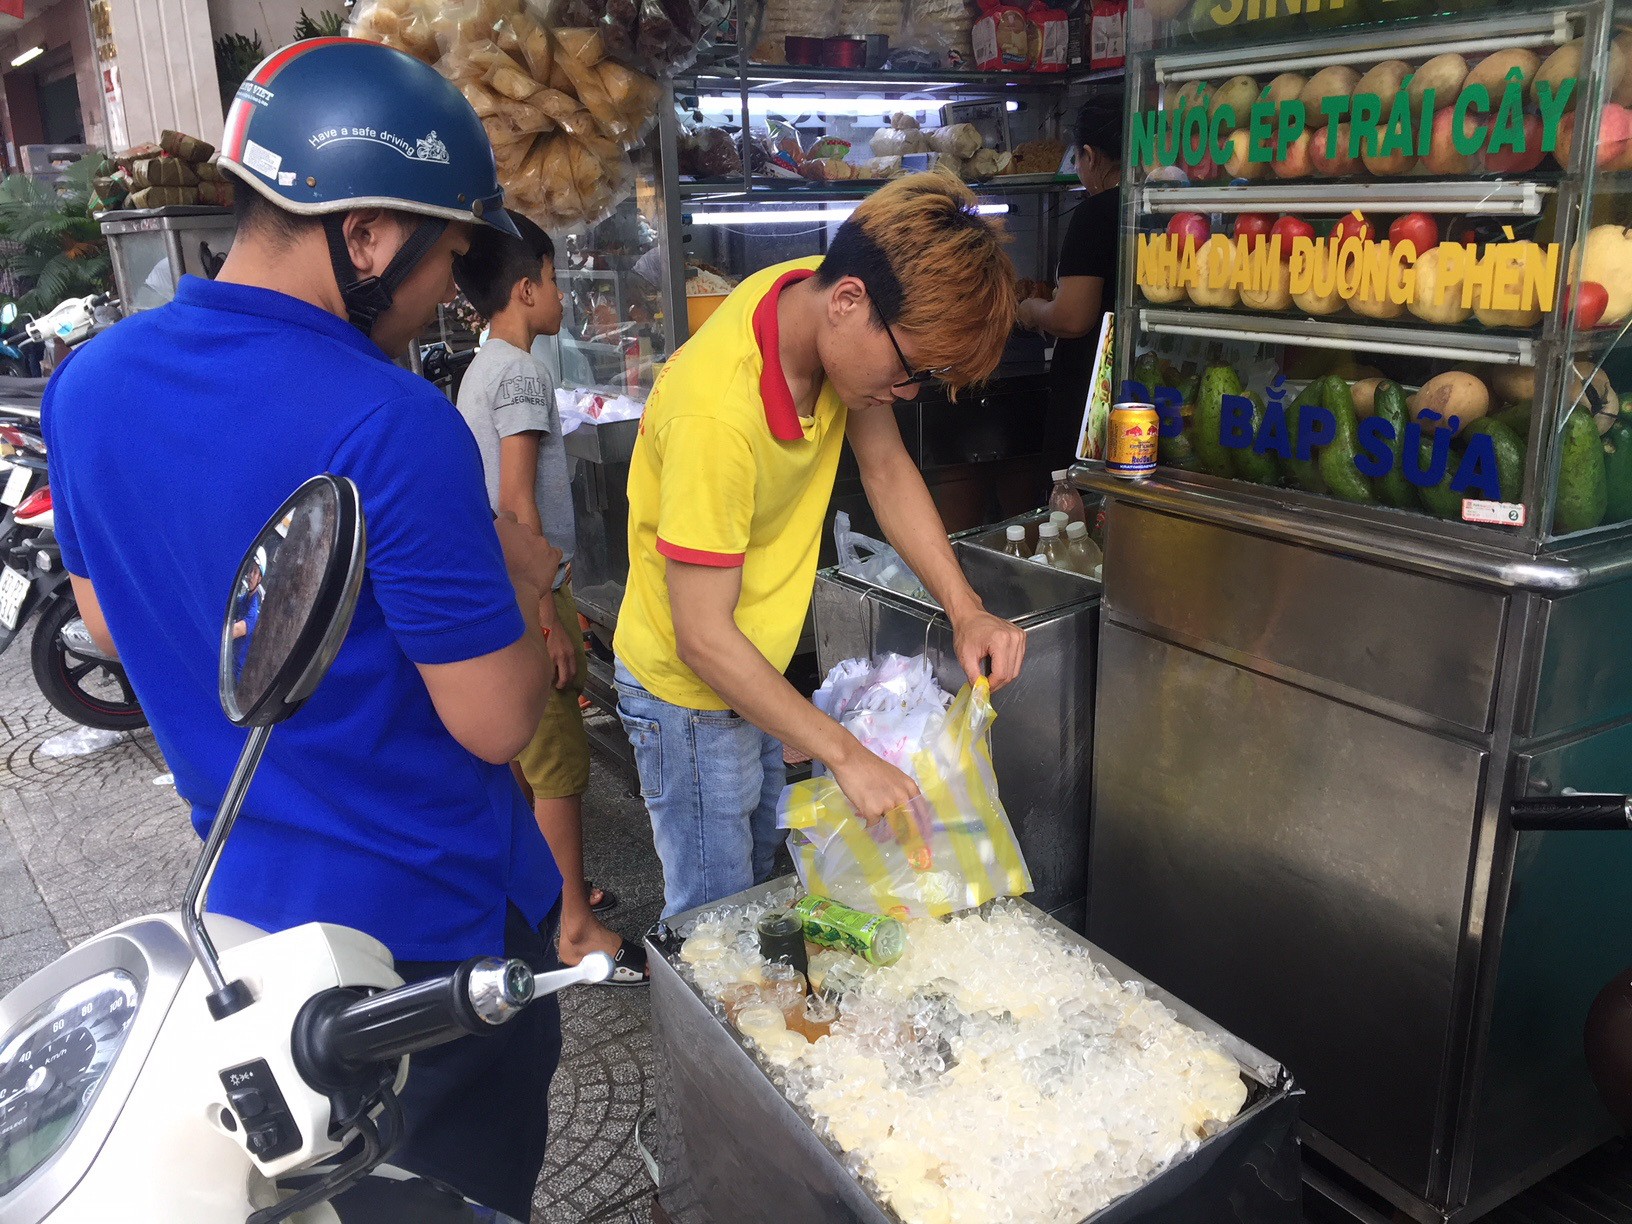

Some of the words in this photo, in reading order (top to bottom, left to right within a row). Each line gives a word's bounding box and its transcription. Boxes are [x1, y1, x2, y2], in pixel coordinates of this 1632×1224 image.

[1131, 82, 1236, 167] NƯỚC
[1249, 85, 1306, 162] ÉP
[1321, 74, 1436, 159] TRÁI
[1452, 66, 1577, 156] CÂY
[308, 128, 337, 147] Have
[341, 127, 348, 135] a
[352, 126, 377, 137] safe
[380, 130, 415, 156] driving
[1137, 233, 1200, 288] NHA
[1289, 208, 1418, 305] ĐƯỜNG
[1436, 225, 1560, 312] PHÈN
[1219, 375, 1337, 461] BẮP
[1353, 408, 1501, 500] SỮA
[81, 1002, 93, 1016] 80
[109, 996, 123, 1013] 100
[53, 1019, 64, 1033] 60
[19, 1050, 31, 1063] 40
[45, 1048, 67, 1065] km/h
